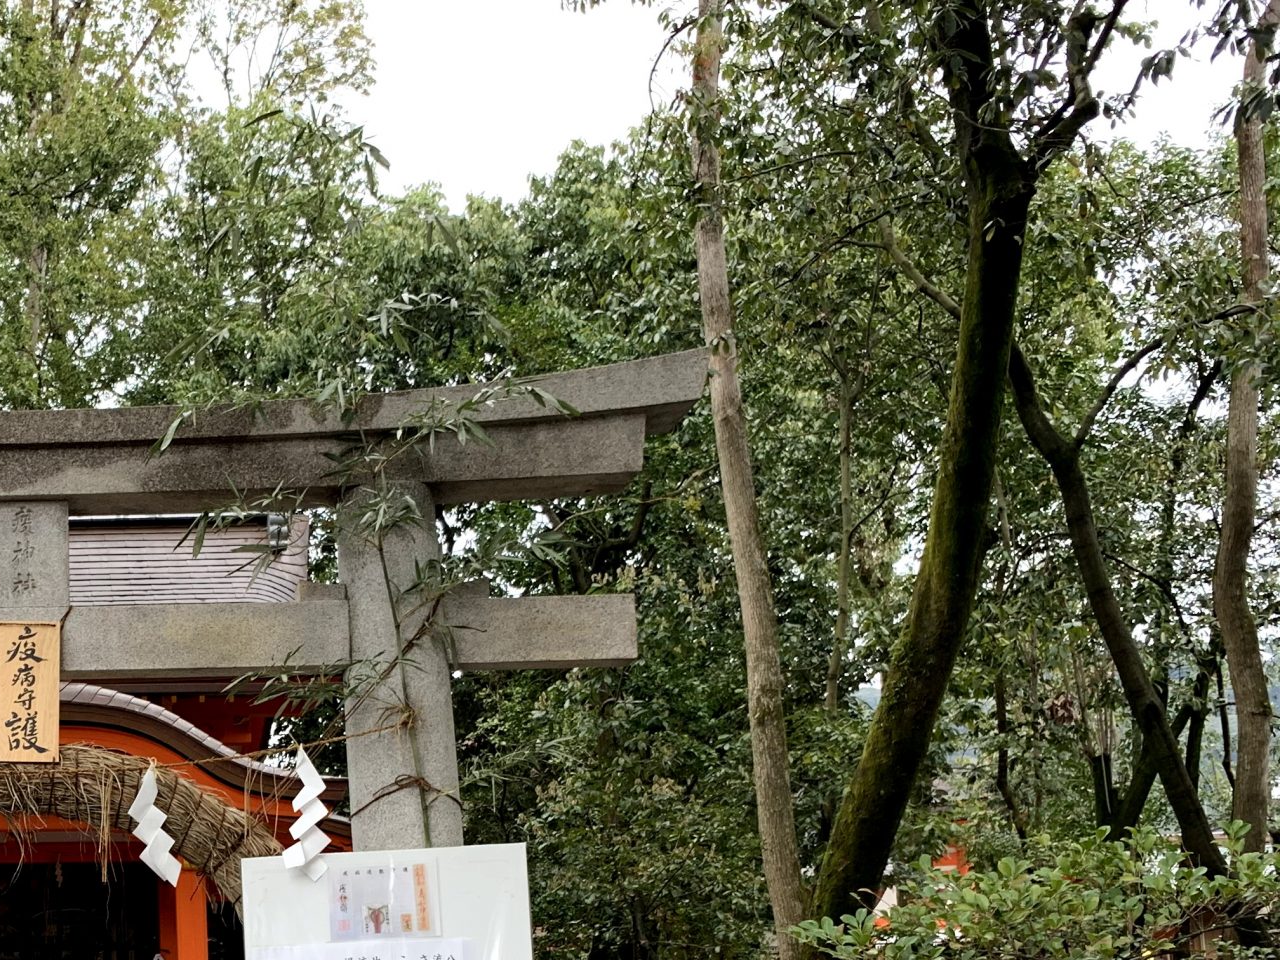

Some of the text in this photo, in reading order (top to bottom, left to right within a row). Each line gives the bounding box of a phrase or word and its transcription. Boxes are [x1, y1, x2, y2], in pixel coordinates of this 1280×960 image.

[11, 505, 38, 594] 疫神社
[5, 625, 50, 754] 疫病守護
